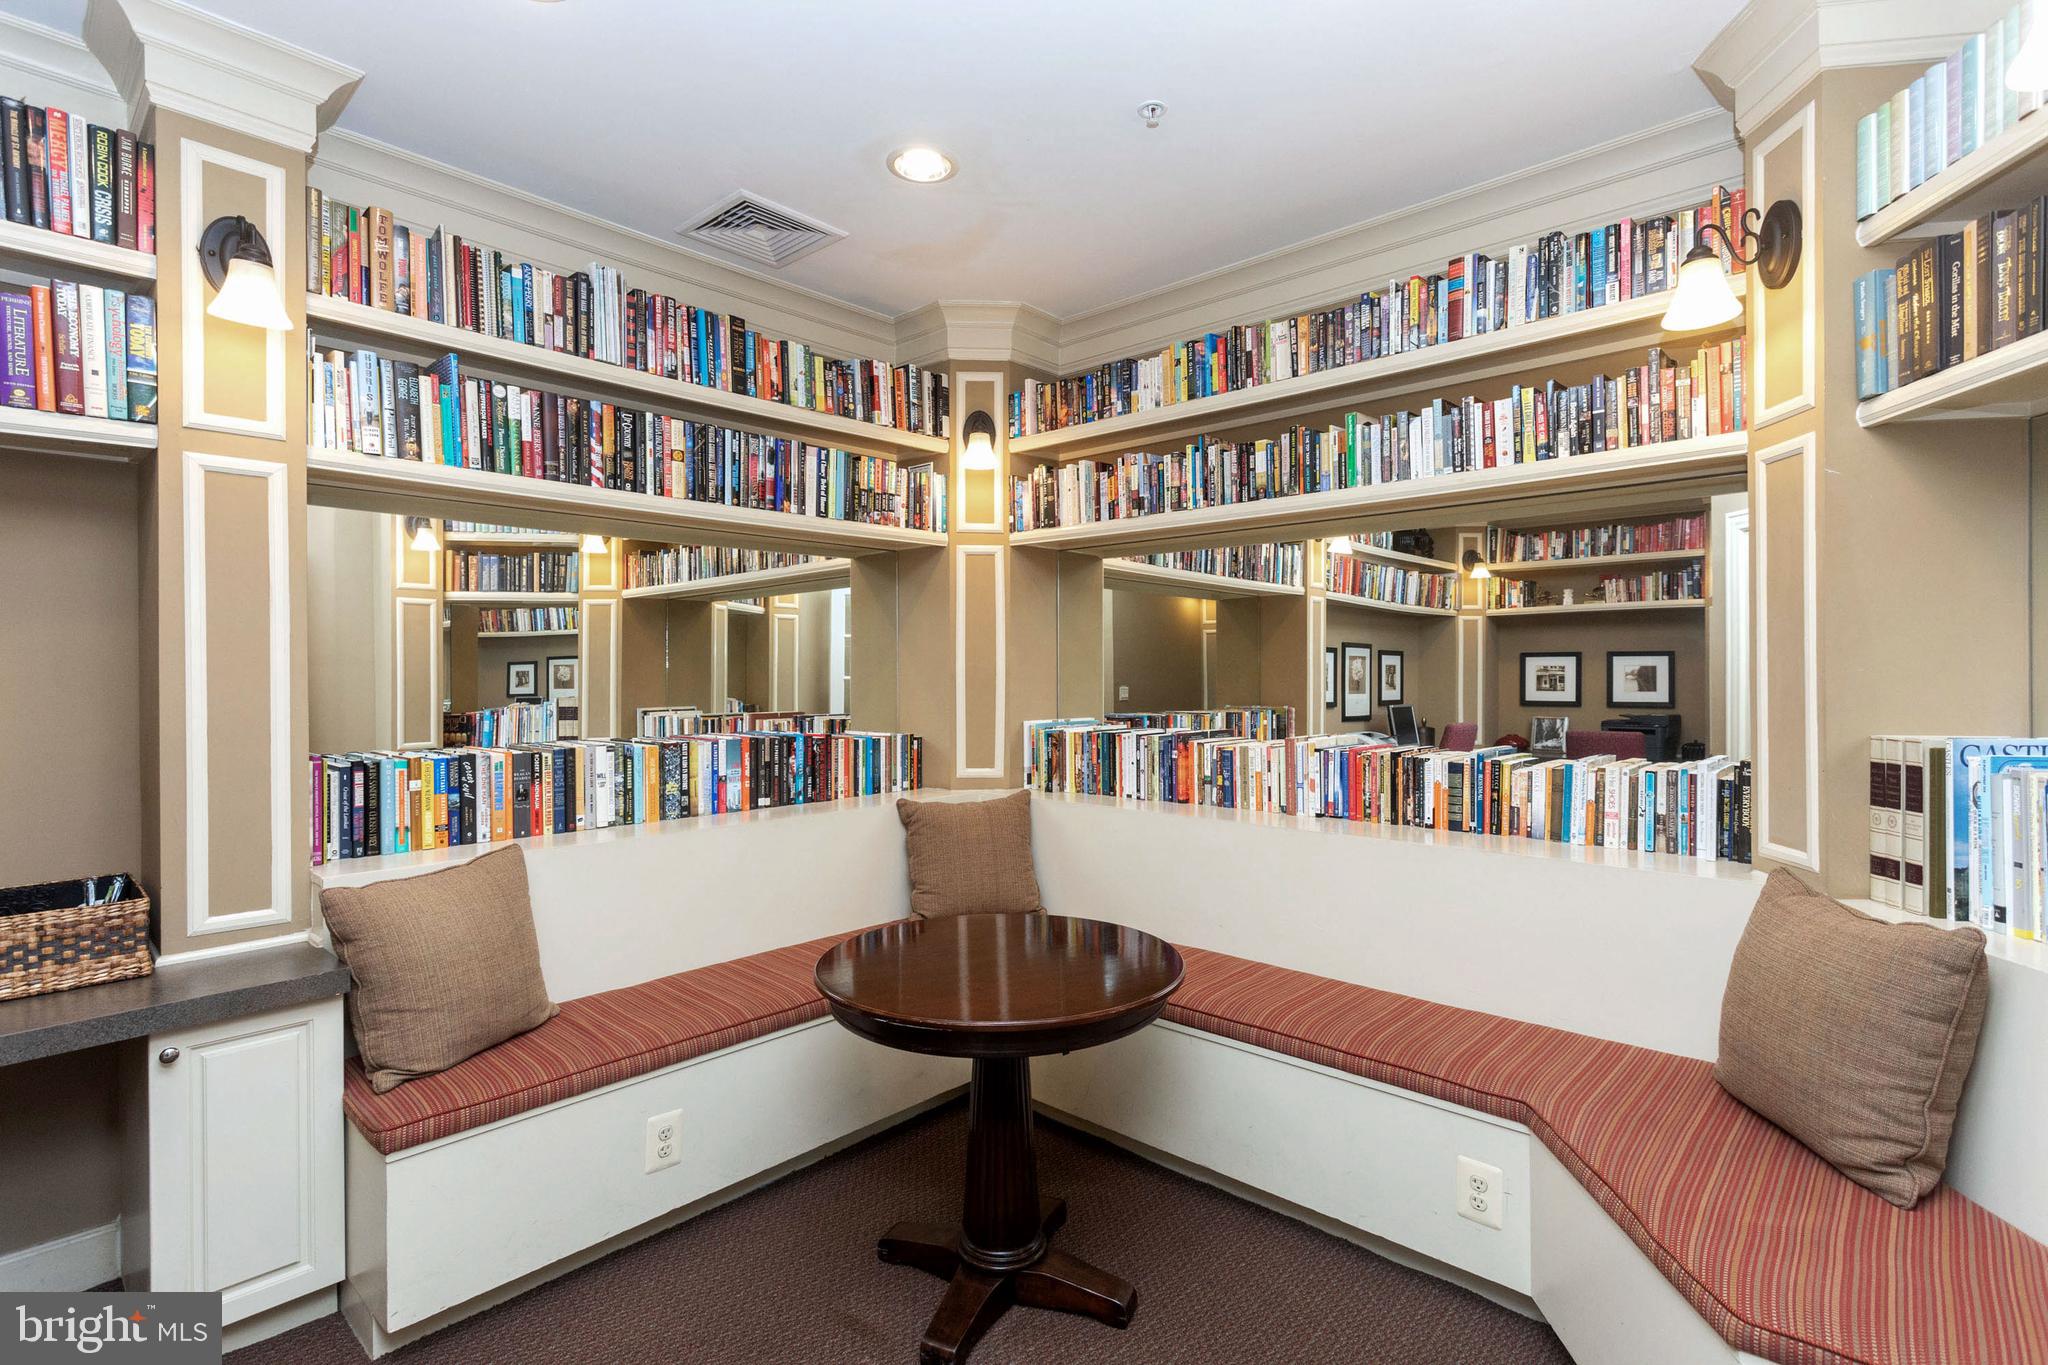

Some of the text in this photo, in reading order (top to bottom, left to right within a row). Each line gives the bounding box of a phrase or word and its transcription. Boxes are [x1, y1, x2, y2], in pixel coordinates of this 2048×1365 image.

[50, 117, 67, 171] MERCY
[97, 131, 108, 188] ROBIN COOK
[121, 136, 132, 177] JAN BURKE
[60, 170, 70, 221] MICHAEL PALMER
[95, 190, 112, 225] CRISIS
[378, 250, 387, 303] WOLFE
[1923, 259, 1931, 278] LOST
[1951, 261, 1960, 294] Gorillas
[56, 288, 66, 318] TODAY
[1924, 278, 1932, 306] SYMBOL
[1952, 295, 1959, 304] in
[68, 289, 79, 357] THE ECONOMY
[108, 294, 125, 356] Psychology
[668, 316, 676, 343] CUSSLER
[1951, 318, 1959, 337] Mist
[14, 308, 29, 376] LITERATURE
[129, 323, 145, 358] TODAY
[398, 378, 408, 400] GEORGE
[409, 377, 418, 405] ELIZABETH
[463, 761, 474, 783] career
[463, 784, 475, 799] evil
[1742, 786, 1750, 829] EVERYBODY
